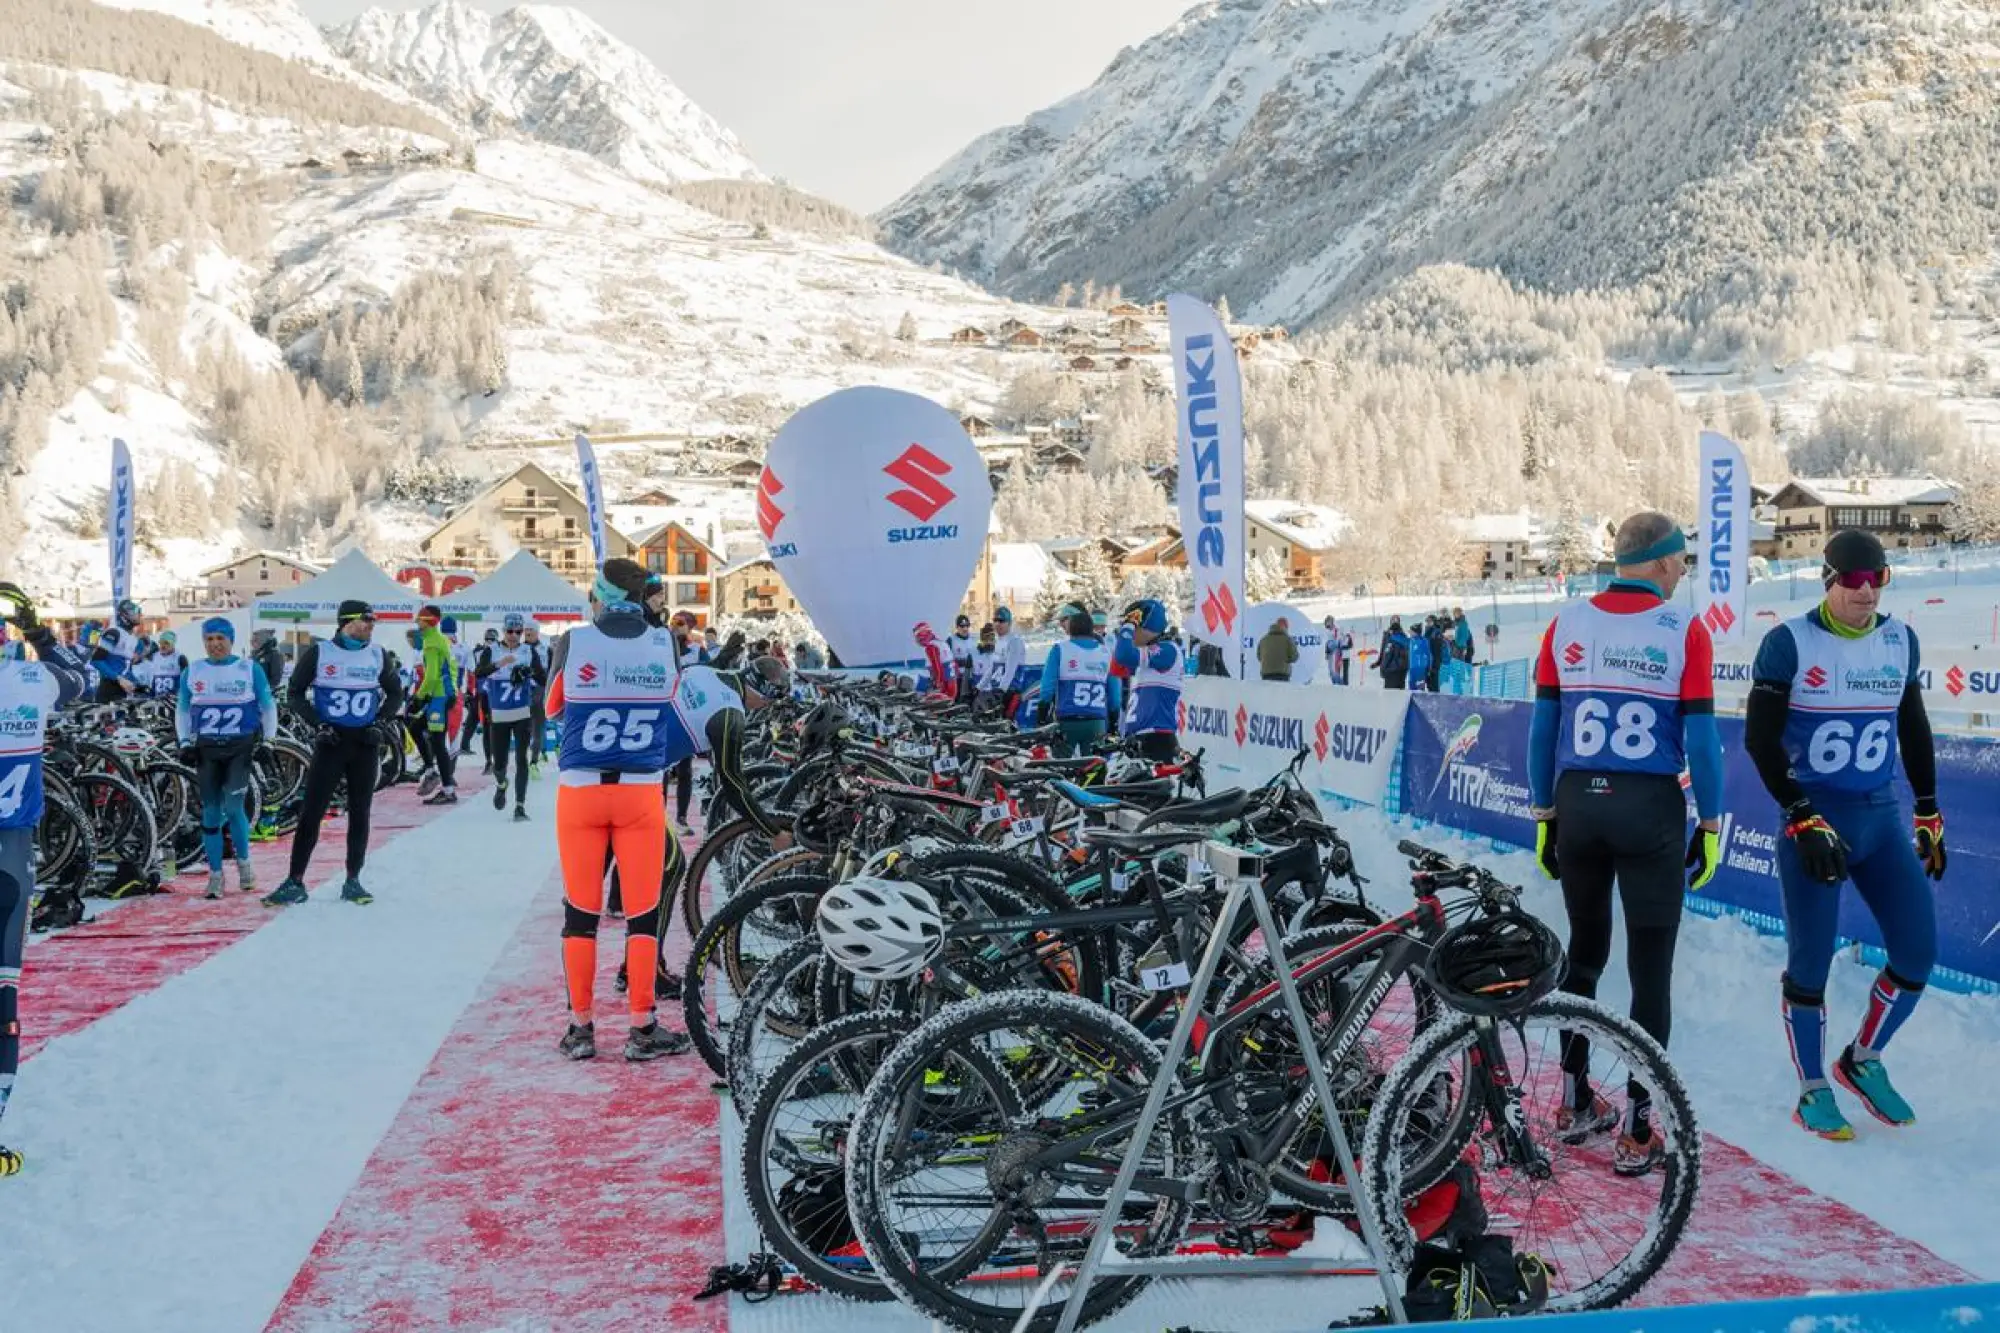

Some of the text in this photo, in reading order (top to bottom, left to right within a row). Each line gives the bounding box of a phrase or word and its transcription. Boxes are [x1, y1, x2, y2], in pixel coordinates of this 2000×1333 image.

[888, 524, 958, 543] SUZUKI
[1603, 659, 1667, 674] TRIATHLON
[327, 690, 371, 717] 30
[1073, 683, 1106, 707] 52
[200, 708, 242, 734] 22
[582, 708, 661, 752] 65
[1188, 705, 1228, 737] SUZUKI
[1250, 713, 1303, 750] SUZUKI
[1574, 698, 1657, 759] 68
[1808, 719, 1891, 774] 66
[1592, 778, 1608, 787] ITA
[1332, 970, 1394, 1061] MOUNTAIN
